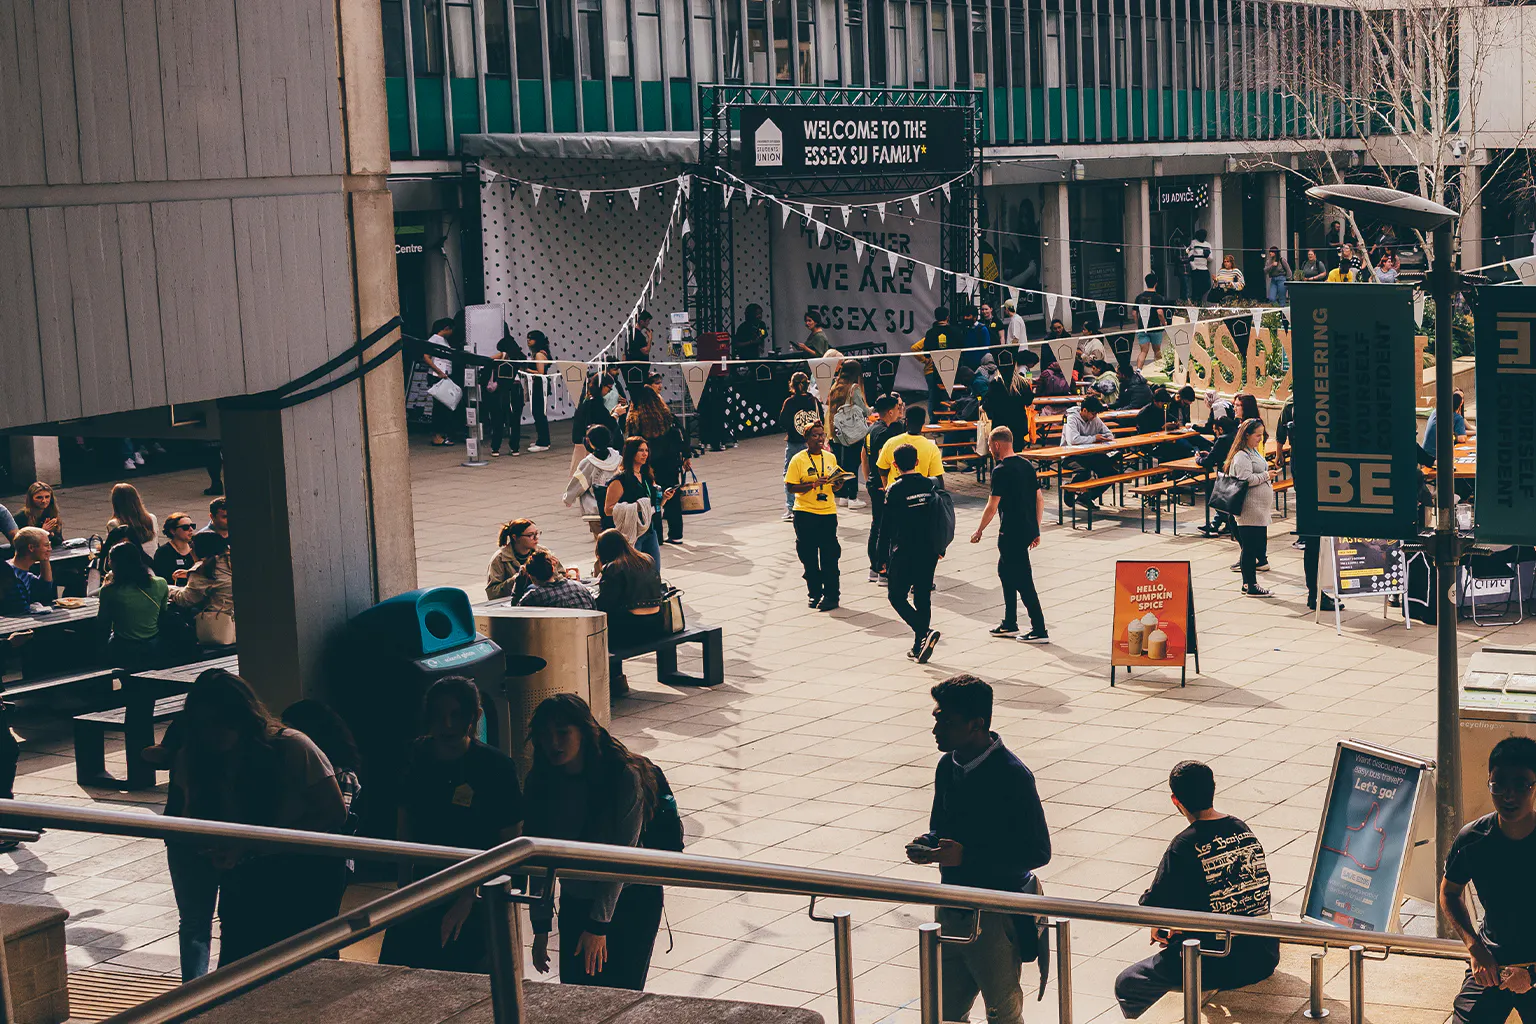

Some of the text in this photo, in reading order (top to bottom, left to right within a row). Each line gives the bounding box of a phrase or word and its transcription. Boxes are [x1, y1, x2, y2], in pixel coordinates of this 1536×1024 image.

[803, 120, 927, 140] WELCOME TO THE
[757, 152, 780, 162] UNION
[804, 146, 847, 166] ESSEX
[850, 145, 868, 165] SU
[1162, 192, 1194, 204] SU ADVICE
[395, 244, 423, 254] Centre
[805, 229, 911, 254] TOGETHER
[806, 262, 912, 294] WE ARE
[807, 304, 915, 334] SSEX SU
[1312, 307, 1330, 449] PIONEERING
[1316, 461, 1394, 505] BE
[1130, 592, 1172, 602] PUMPKIN
[1136, 584, 1166, 593] HELLO,
[1138, 601, 1164, 610] SPICE
[1460, 721, 1494, 730] ecycling
[1356, 754, 1408, 775] Want discounted
[1354, 766, 1404, 785] easy bus travel?
[1354, 778, 1397, 800] Let's go!
[1194, 842, 1212, 858] Les
[1210, 896, 1238, 912] Wind
